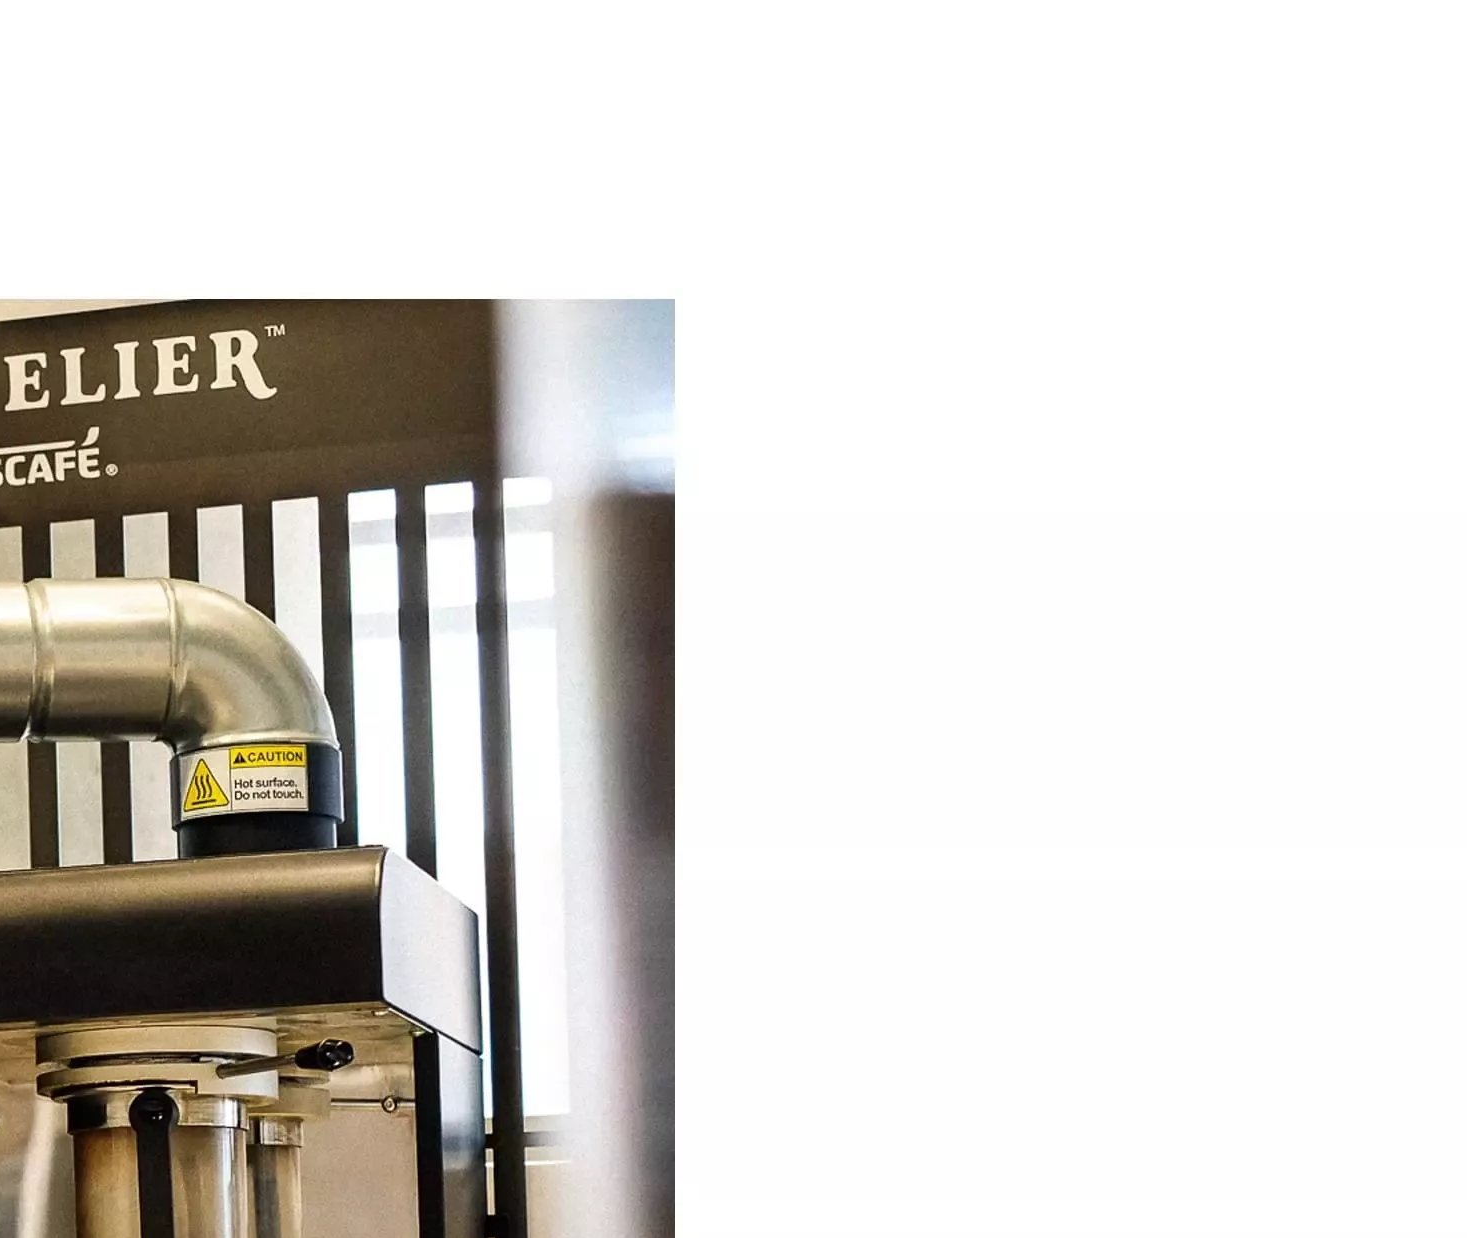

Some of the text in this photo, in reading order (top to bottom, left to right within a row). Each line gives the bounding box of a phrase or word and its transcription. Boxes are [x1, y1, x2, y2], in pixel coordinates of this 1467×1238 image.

[247, 751, 303, 763] CAUTION
[234, 777, 298, 789] Hot surface.
[234, 789, 304, 801] Do not touch.
